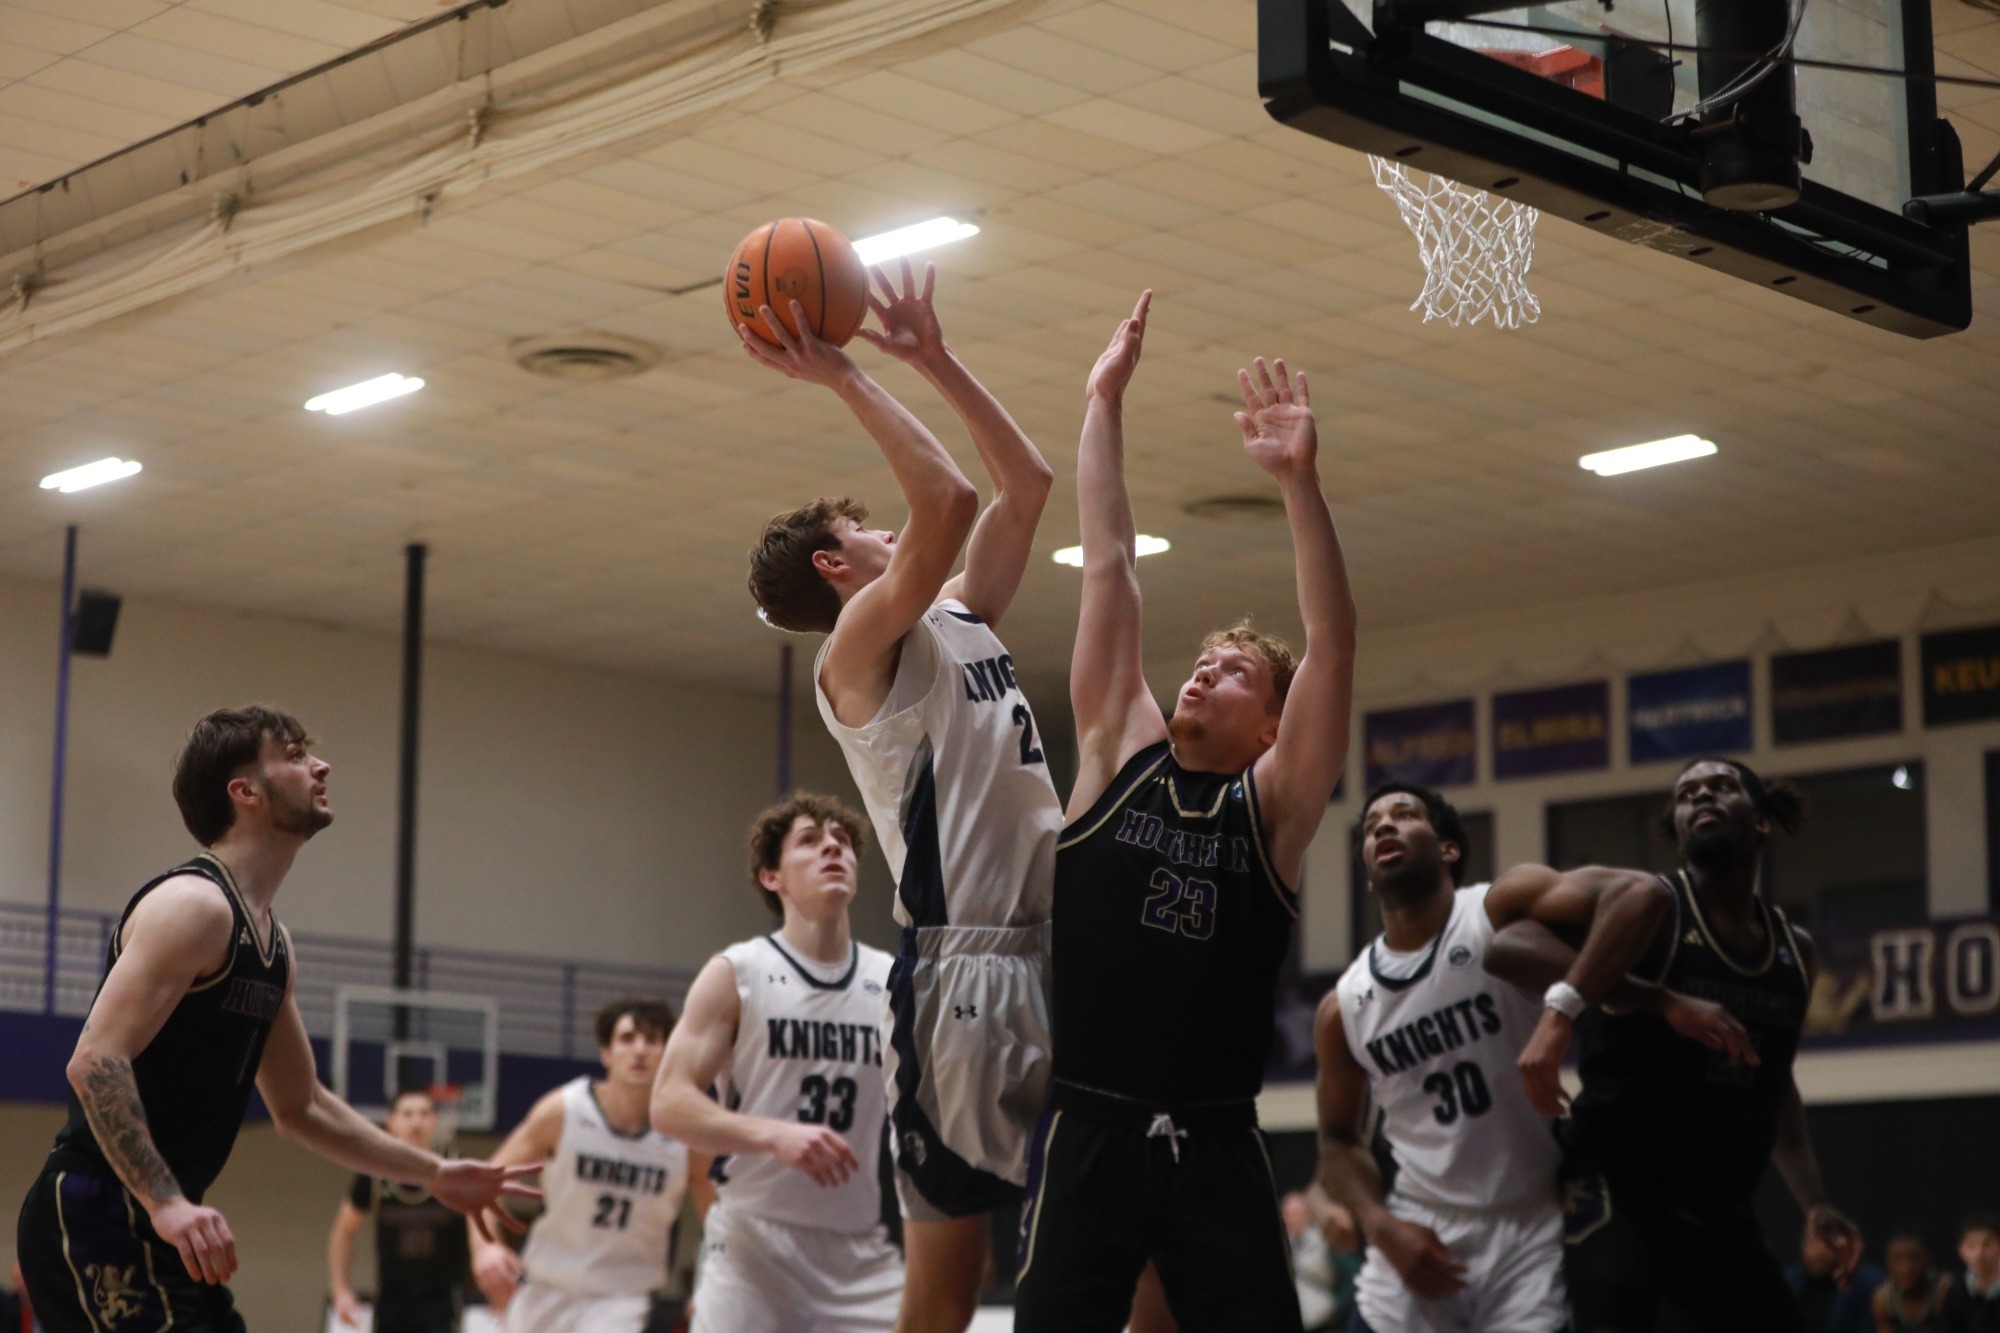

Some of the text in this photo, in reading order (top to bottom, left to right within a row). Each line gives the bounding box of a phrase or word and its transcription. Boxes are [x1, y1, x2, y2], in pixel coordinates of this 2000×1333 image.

[1141, 867, 1217, 941] 23
[1870, 922, 2000, 1022] HO
[1366, 993, 1501, 1077] KNIGHTS
[798, 1074, 857, 1133] 33
[1423, 1061, 1492, 1125] 30
[576, 1153, 667, 1196] KNIGHTS
[593, 1194, 631, 1231] 21
